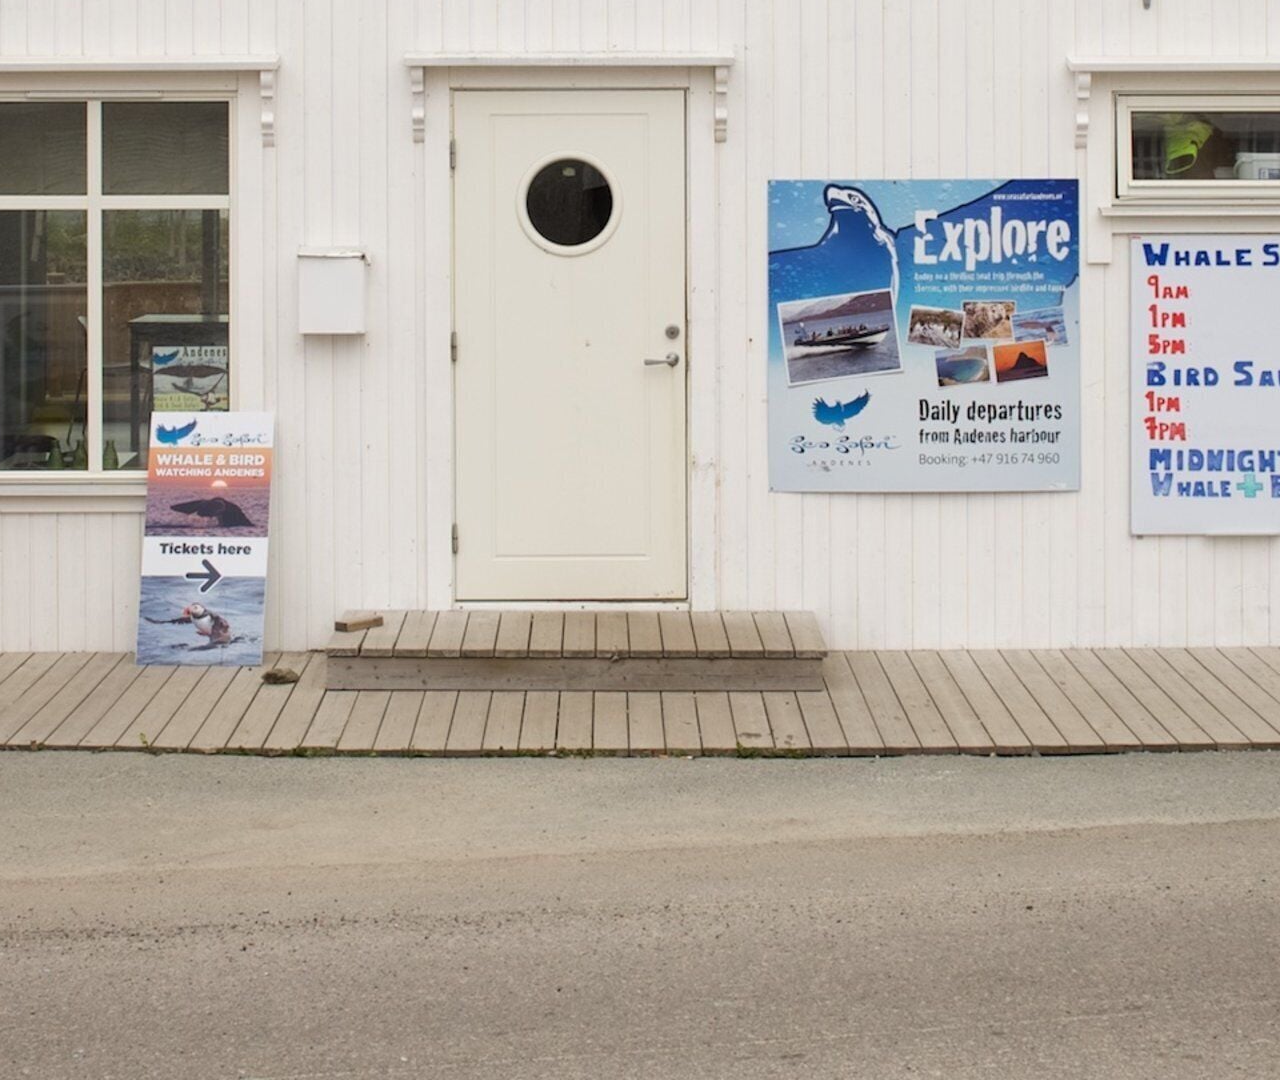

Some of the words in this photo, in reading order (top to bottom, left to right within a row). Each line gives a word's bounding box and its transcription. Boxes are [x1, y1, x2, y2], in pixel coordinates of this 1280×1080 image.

[914, 206, 1071, 271] Explore
[1143, 243, 1252, 266] WHALE
[1147, 275, 1189, 299] 9AM
[1148, 304, 1186, 328] 1PM
[1148, 334, 1186, 355] 5PM
[1147, 361, 1219, 386] BIRD
[919, 399, 960, 424] Daily
[967, 400, 1062, 424] departures
[1145, 392, 1181, 412] 1PM
[919, 428, 949, 444] from
[954, 428, 1006, 444] Andenes
[1010, 427, 1061, 444] harbour
[156, 454, 213, 466] WHALE
[216, 454, 226, 466] &
[229, 454, 265, 466] BIRD
[919, 453, 969, 468] Booking:
[971, 453, 993, 465] +47
[996, 452, 1019, 465] 916
[1021, 452, 1035, 465] 74
[1037, 452, 1060, 465] 960
[155, 468, 212, 476] WATCHING
[214, 468, 265, 476] ANDENES
[1151, 472, 1231, 497] WHALE
[160, 543, 214, 554] Tickets
[218, 543, 252, 554] here
